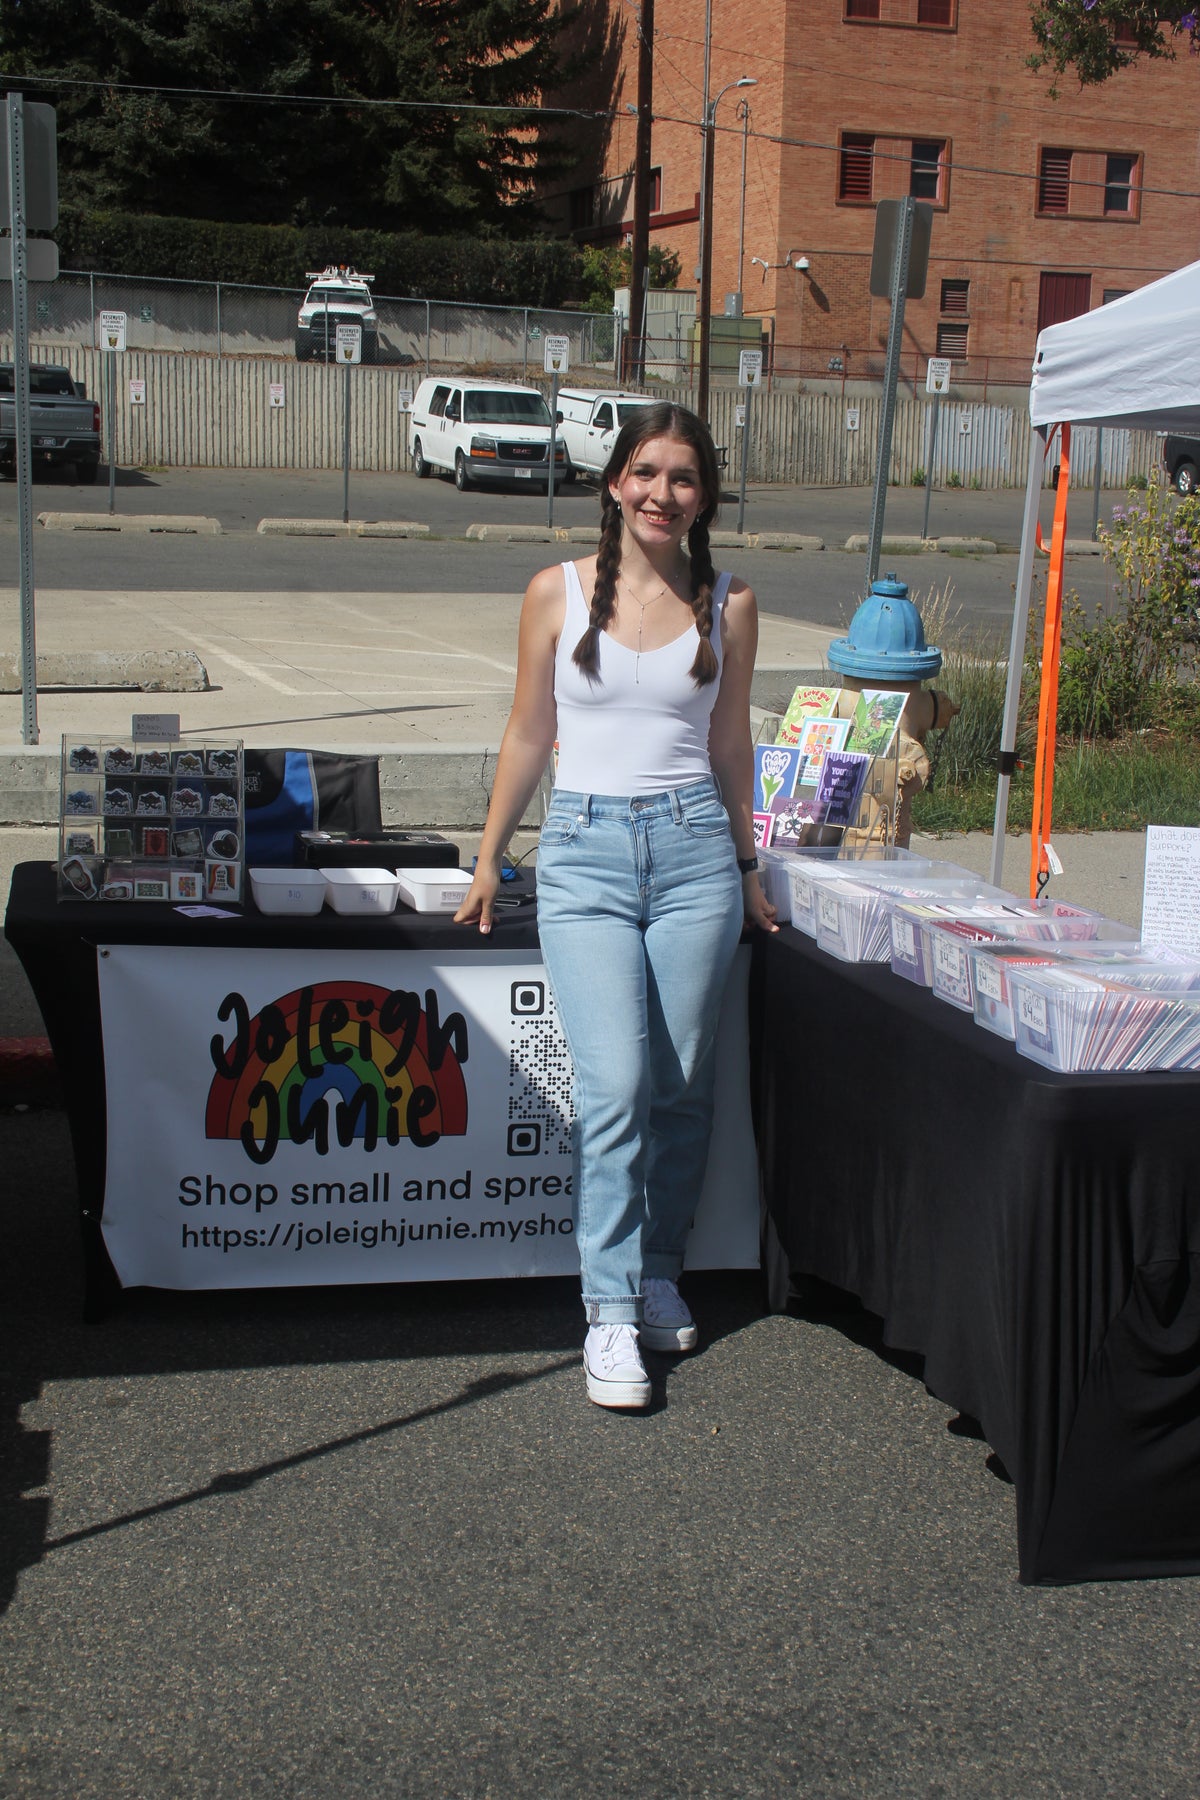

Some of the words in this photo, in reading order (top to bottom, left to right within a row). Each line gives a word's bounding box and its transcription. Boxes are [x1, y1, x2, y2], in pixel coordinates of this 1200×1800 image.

[1150, 828, 1178, 841] What
[1150, 842, 1192, 853] support?
[288, 890, 301, 899] $10
[1024, 1002, 1033, 1021] $4
[210, 985, 468, 1079] Joleigh
[241, 1079, 441, 1165] Junie
[178, 1175, 279, 1213] Shop
[290, 1172, 390, 1206] small
[402, 1170, 472, 1203] and
[181, 1213, 574, 1252] https://joleighjunie.mysho
